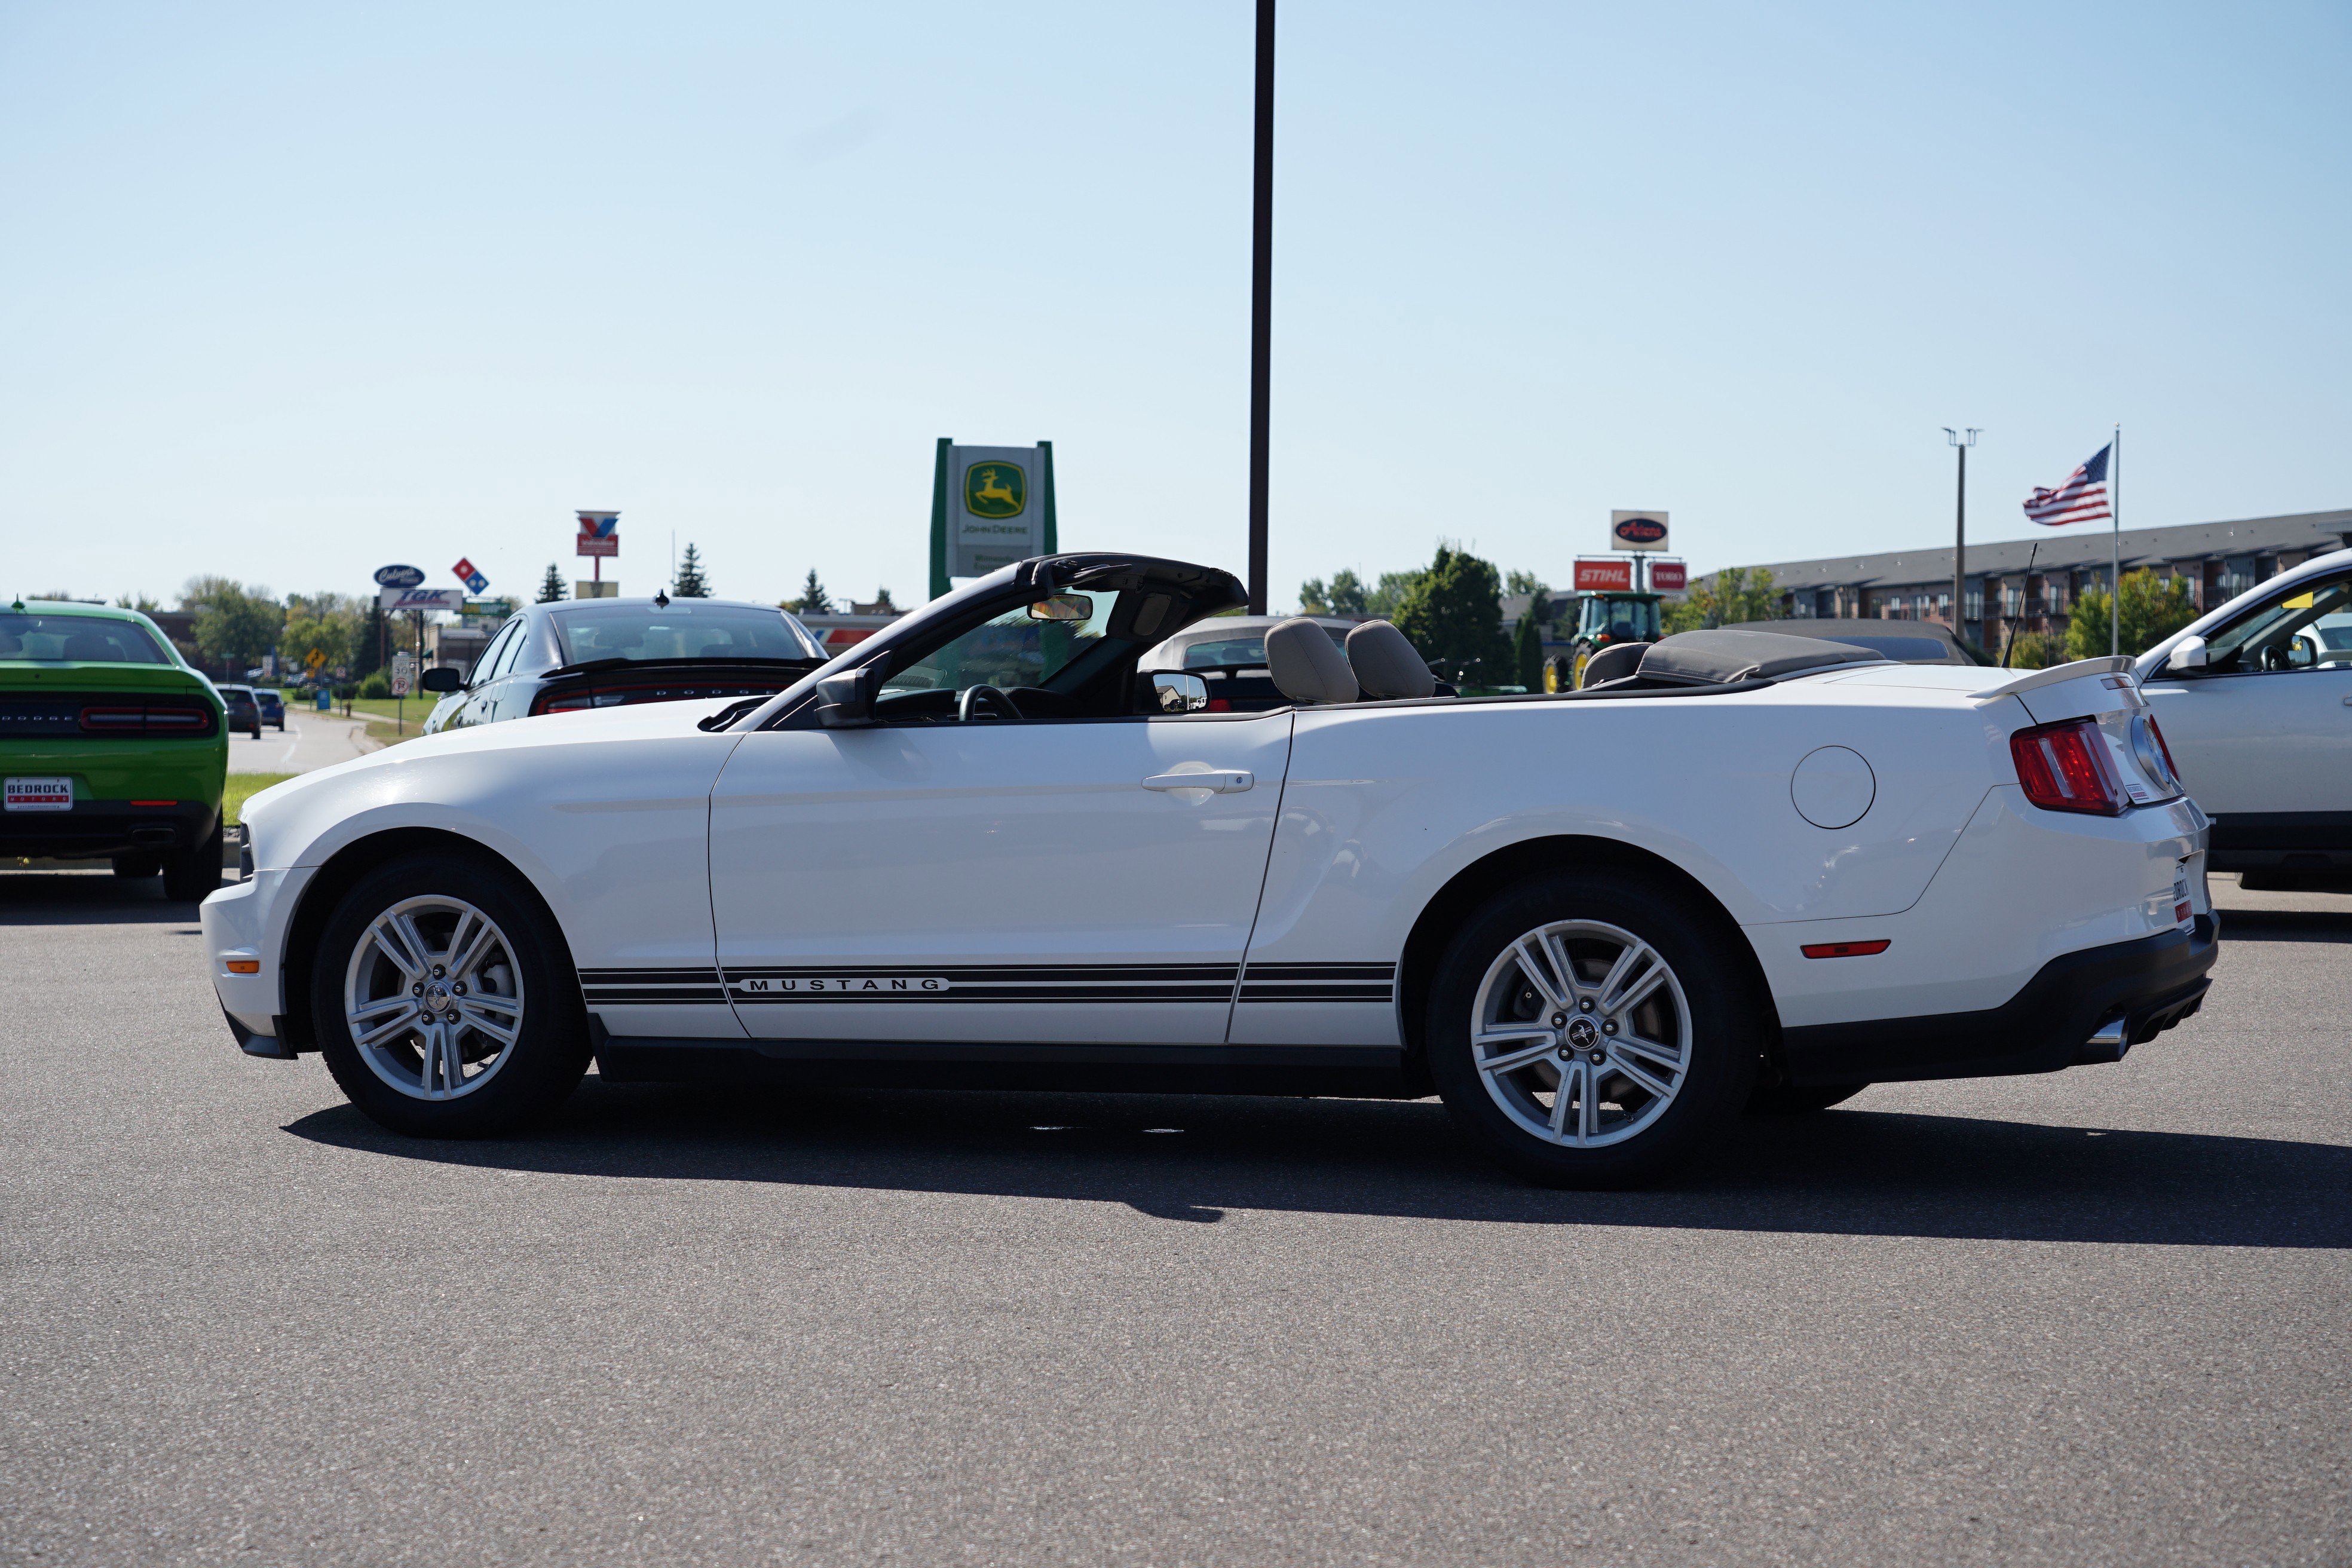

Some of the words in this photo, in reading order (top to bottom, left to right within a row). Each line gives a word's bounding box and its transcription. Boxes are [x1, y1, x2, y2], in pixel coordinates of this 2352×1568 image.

[963, 525, 990, 534] JOHN
[993, 525, 1028, 534] DEERE
[1579, 569, 1627, 582] STIHL
[1654, 571, 1684, 582] TORO
[400, 590, 448, 601] TGK
[8, 784, 68, 794] BEDROCK
[749, 979, 939, 990] MUSTANG
